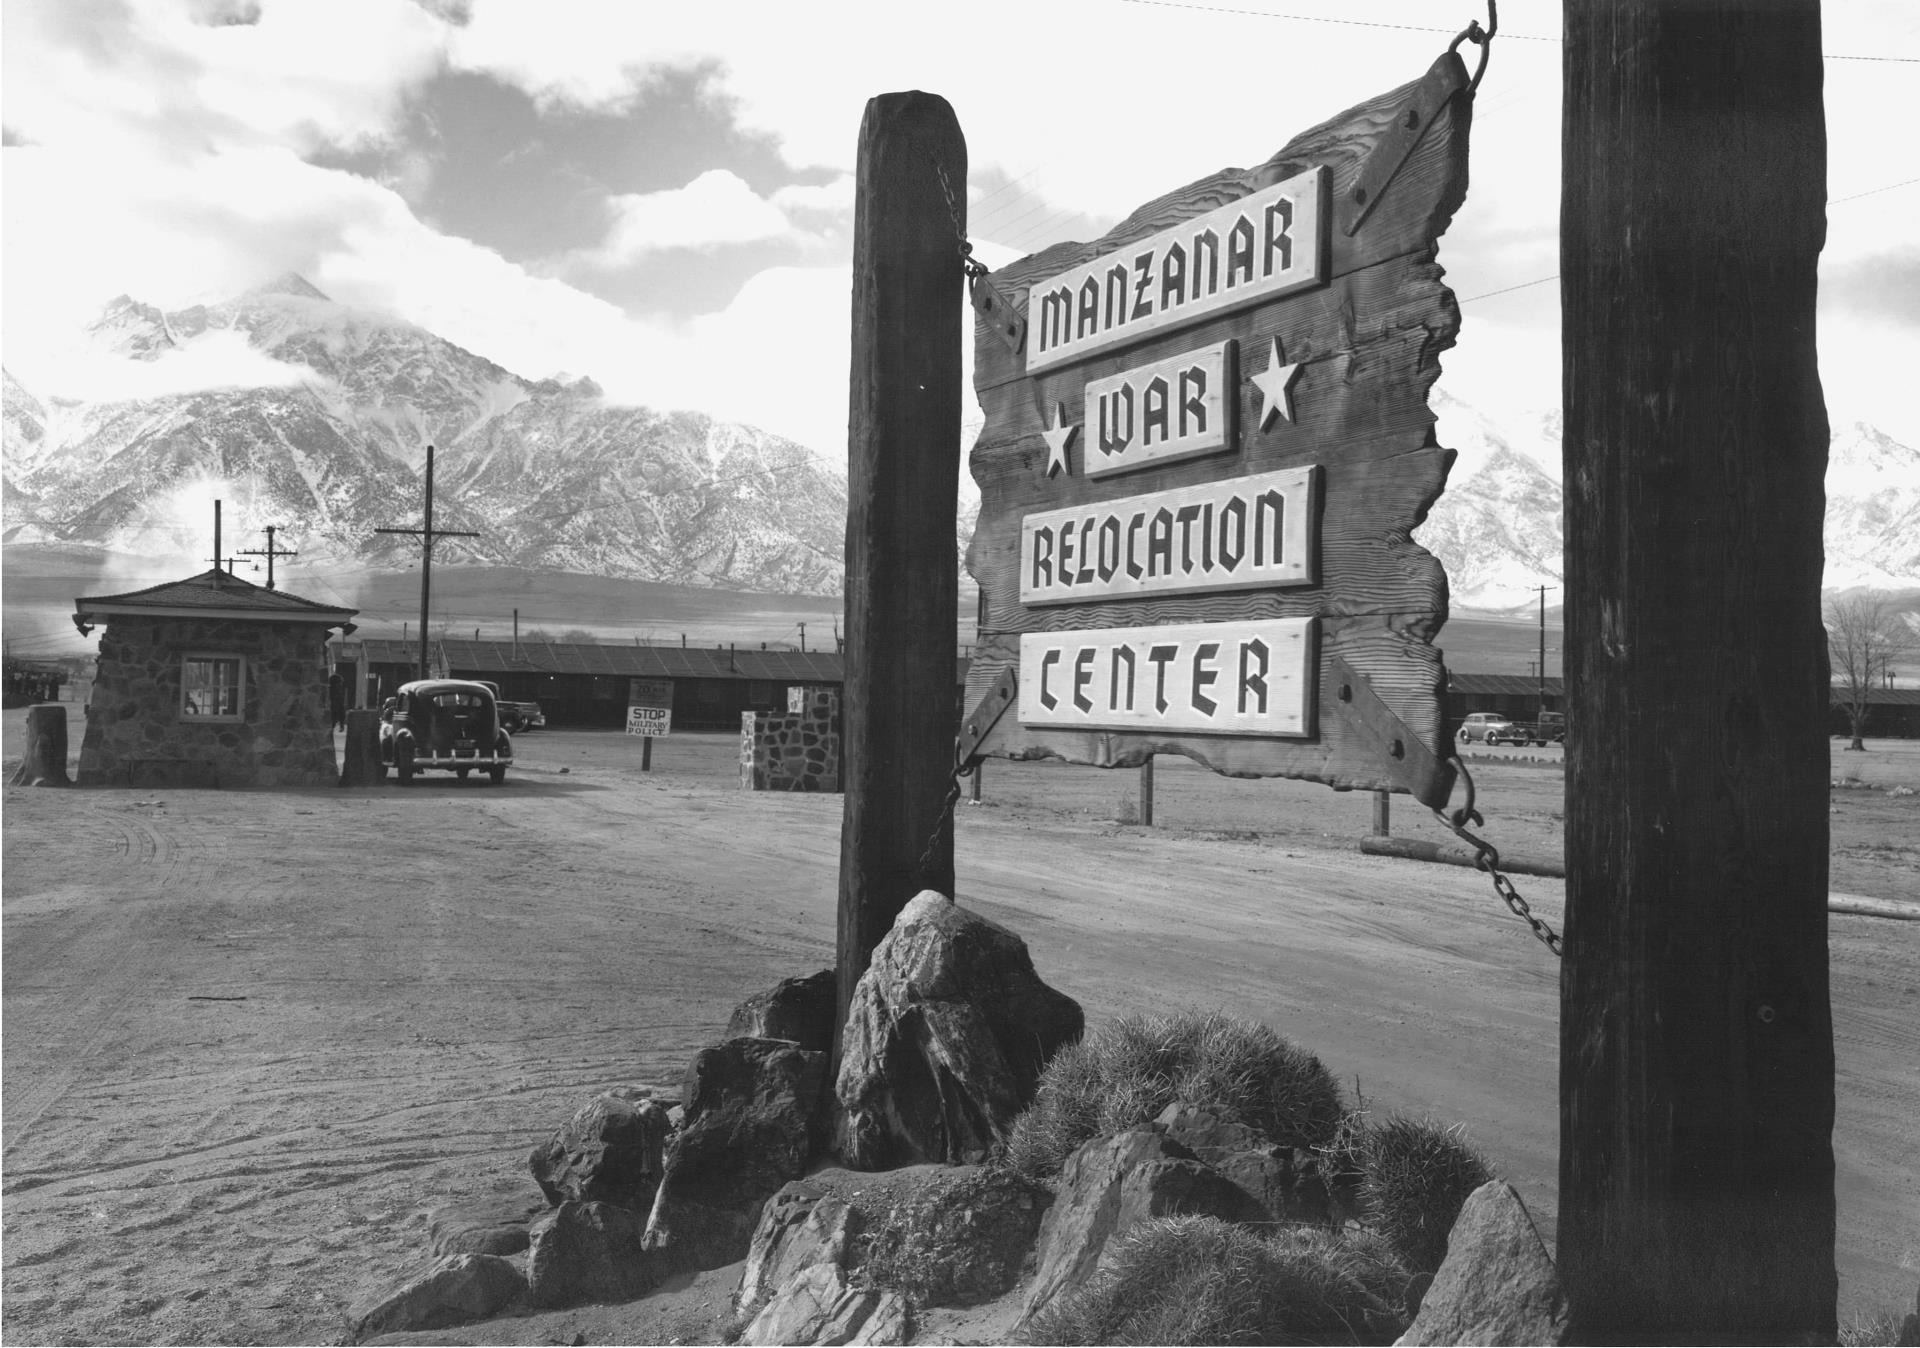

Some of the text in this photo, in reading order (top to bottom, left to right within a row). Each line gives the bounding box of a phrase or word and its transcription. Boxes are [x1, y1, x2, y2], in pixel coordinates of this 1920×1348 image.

[1040, 197, 1293, 352] MANZANAR
[1099, 365, 1208, 456] WAR
[1033, 489, 1285, 589] RELOCATION
[633, 708, 666, 720] STOP
[1041, 638, 1269, 716] CENTER
[629, 720, 668, 729] MILITARY
